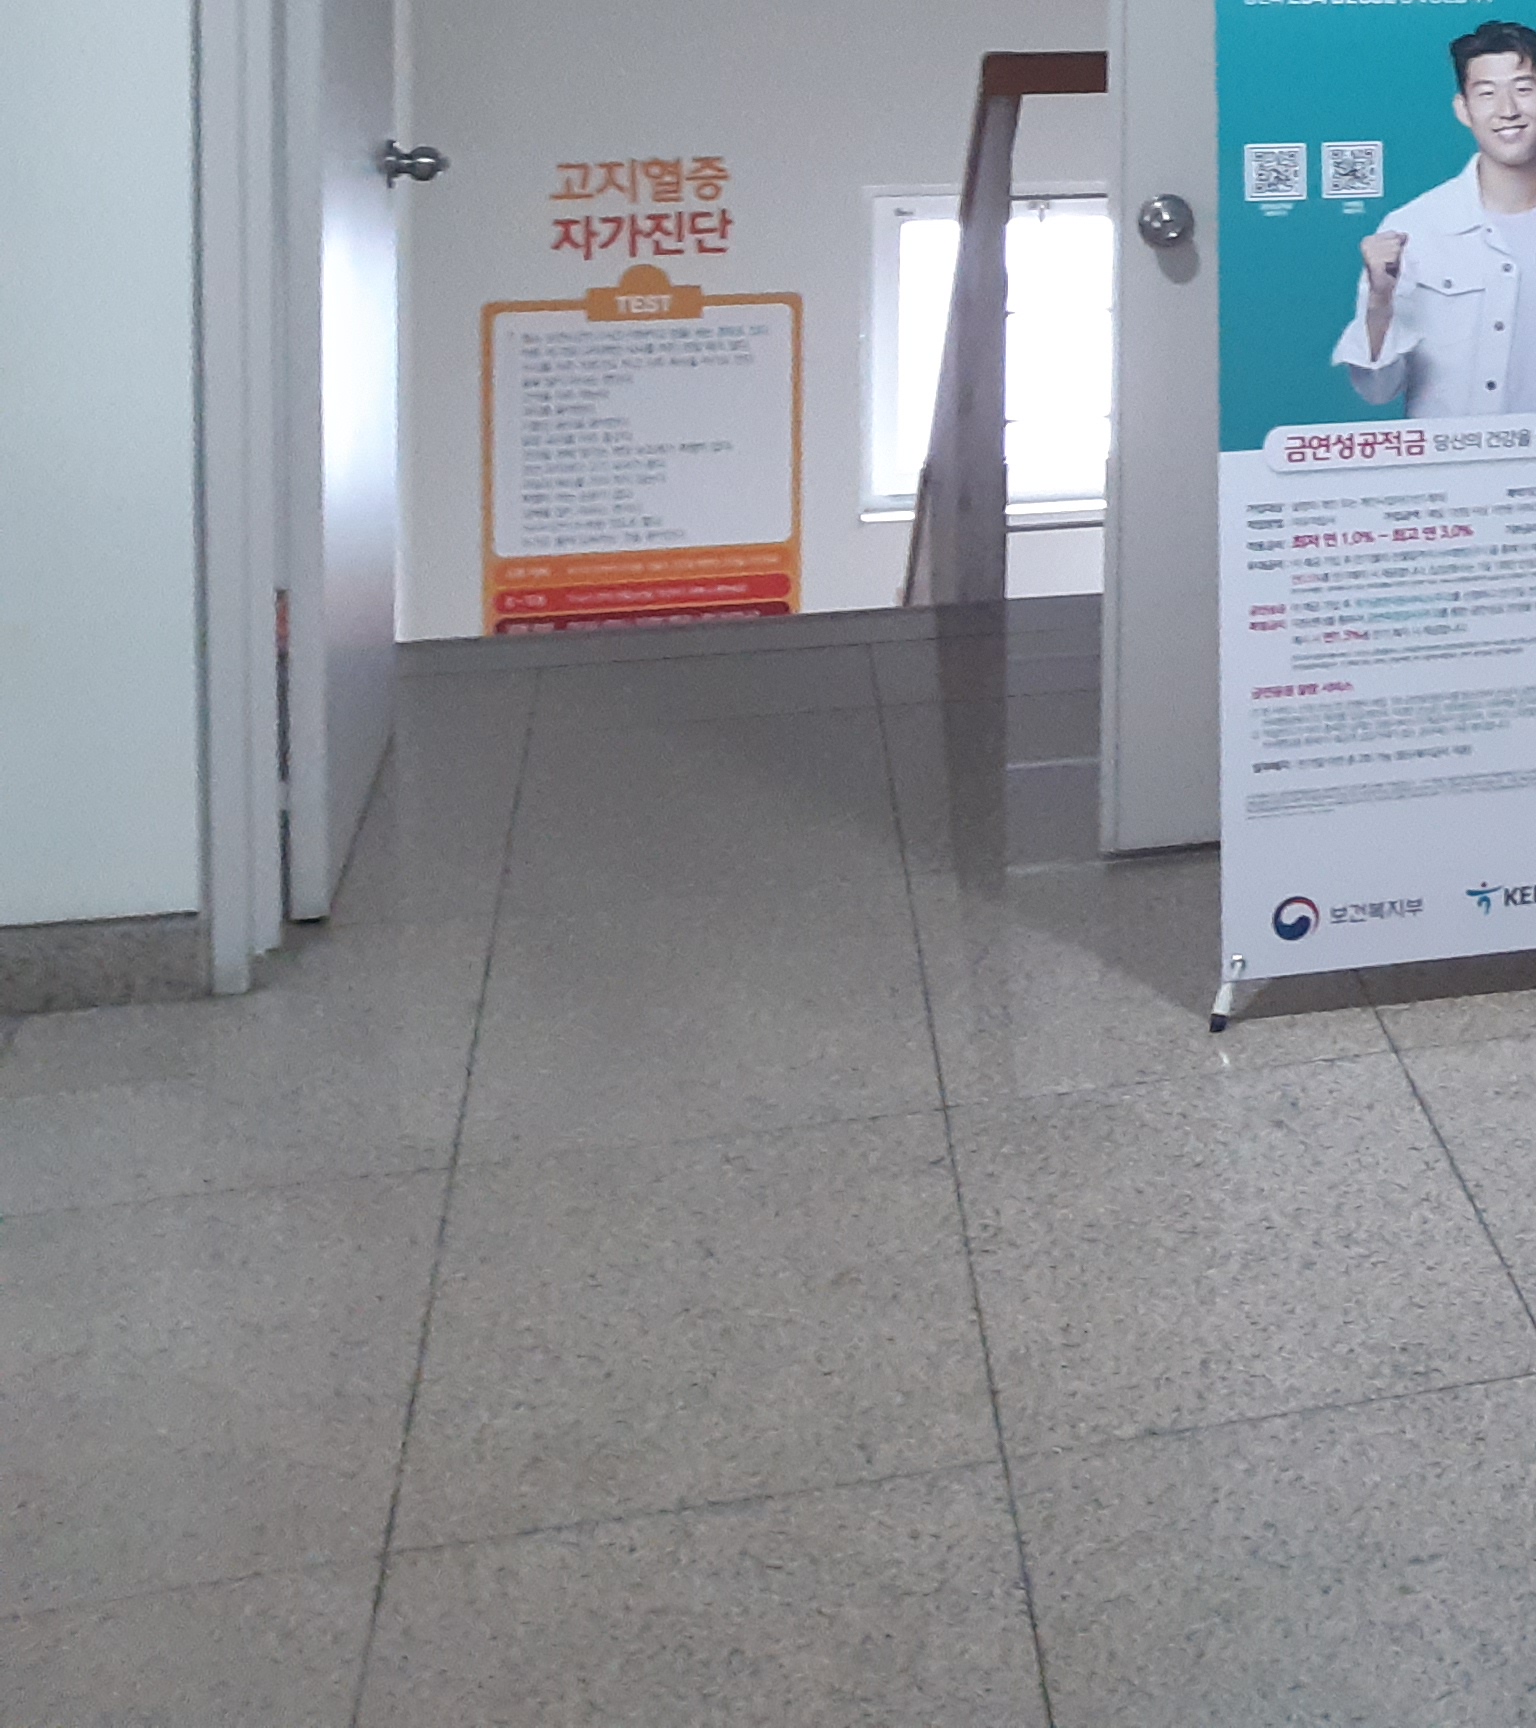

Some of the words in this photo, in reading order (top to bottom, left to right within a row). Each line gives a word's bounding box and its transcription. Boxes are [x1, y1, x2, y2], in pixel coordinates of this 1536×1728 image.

[551, 155, 732, 203] 고지혈증
[551, 209, 734, 261] 자가진단
[615, 294, 673, 313] TEST
[1284, 429, 1427, 463] 금연성공적금
[1433, 432, 1482, 451] 당신의
[1486, 429, 1531, 448] 건강을
[1330, 898, 1424, 924] 보건복지부
